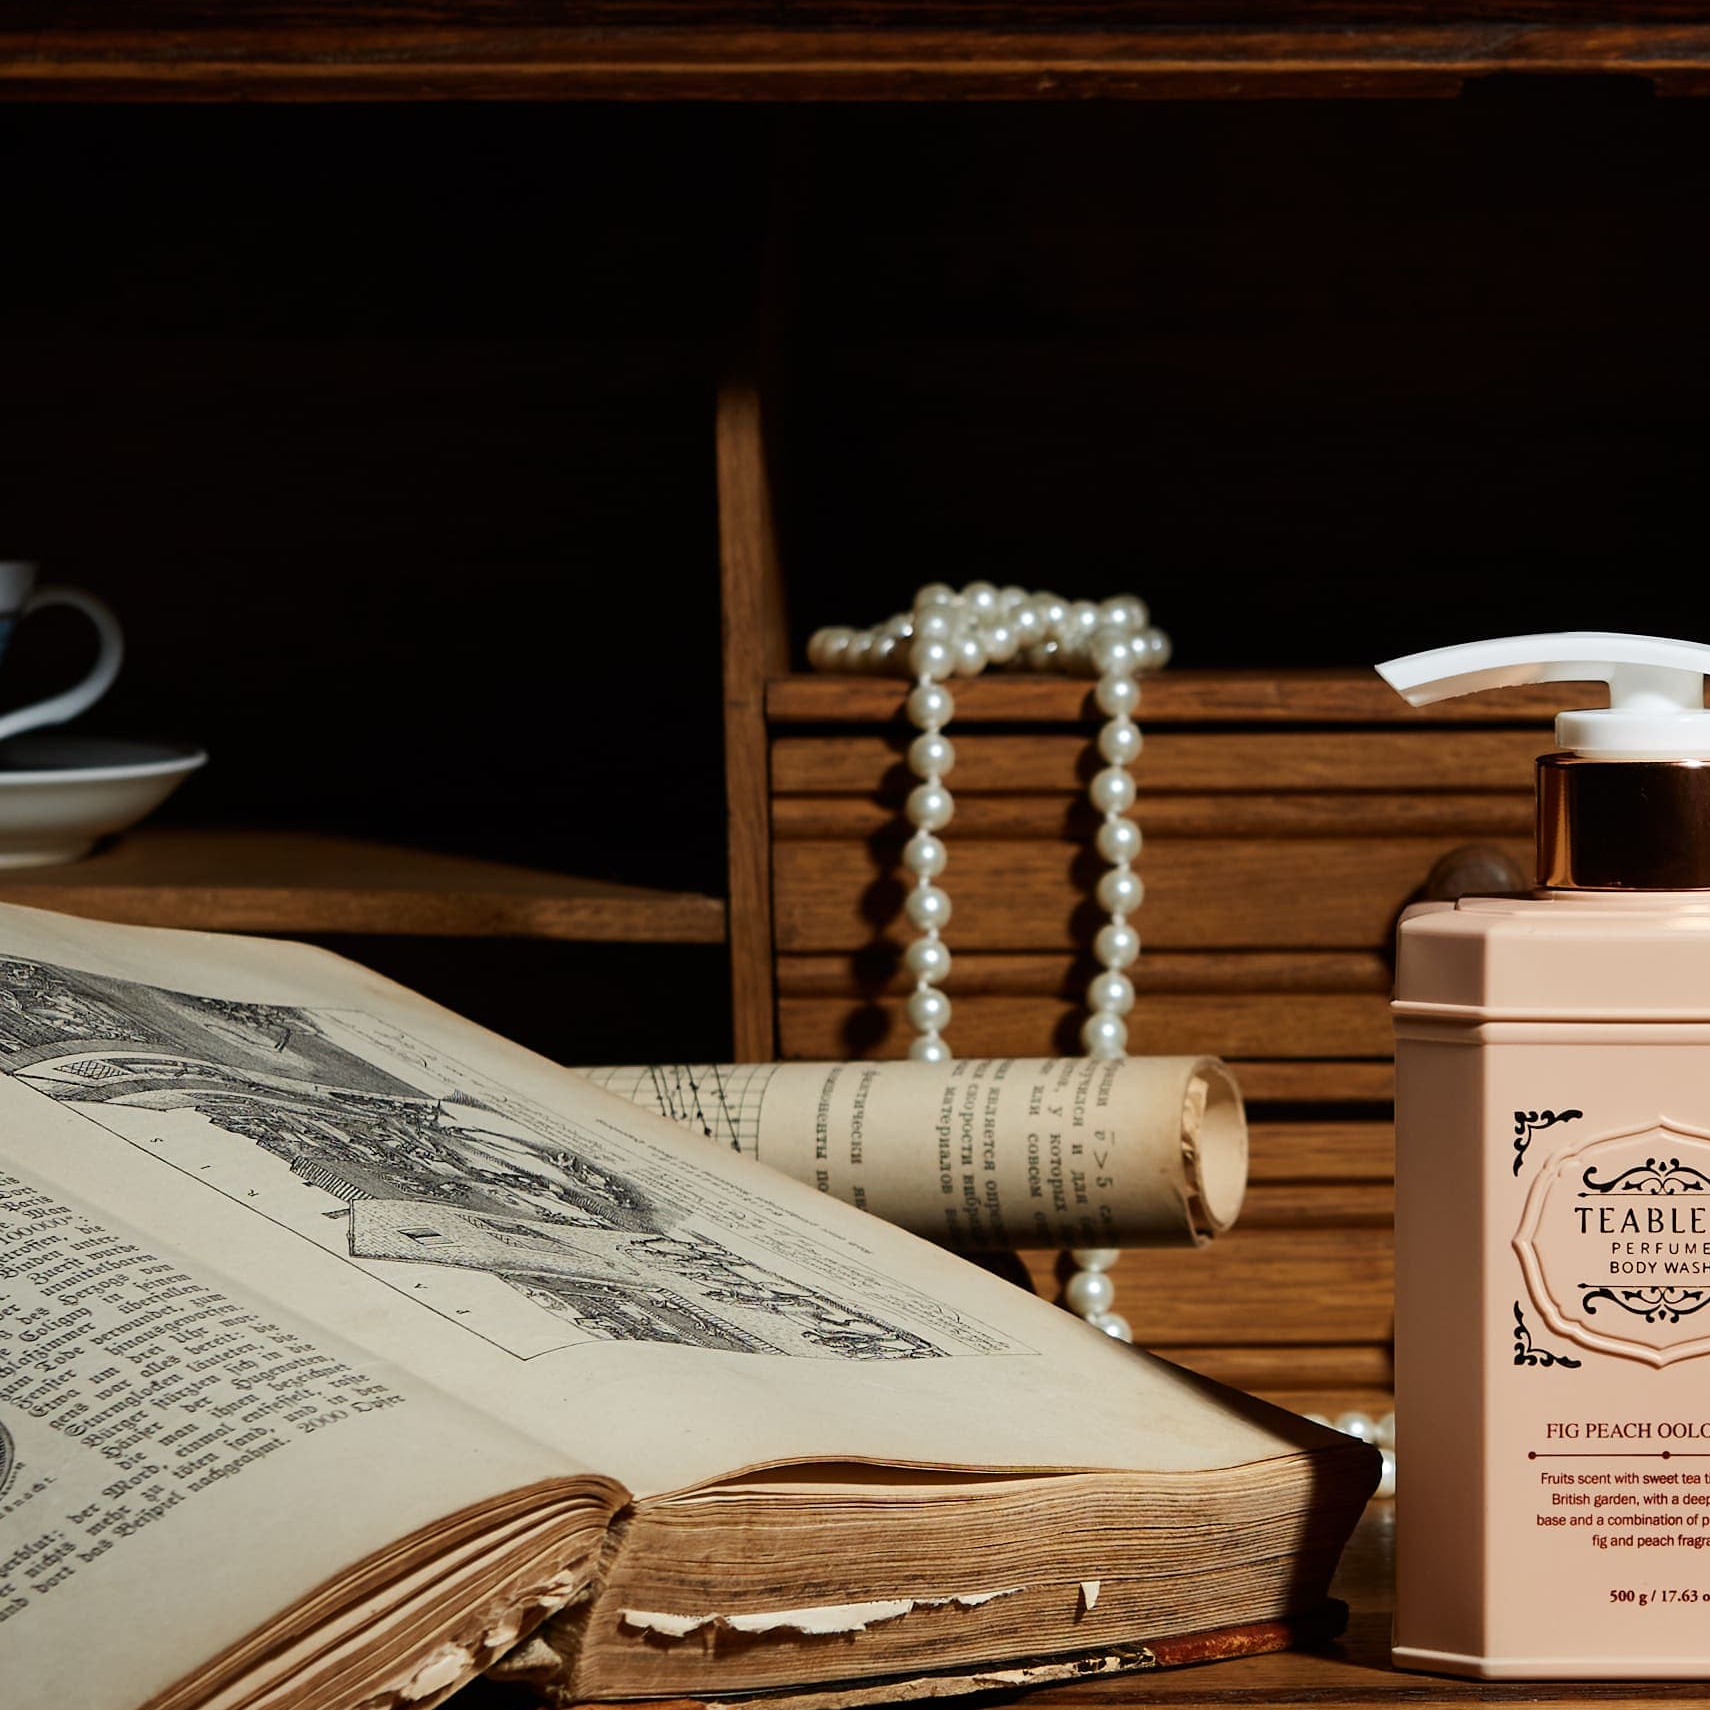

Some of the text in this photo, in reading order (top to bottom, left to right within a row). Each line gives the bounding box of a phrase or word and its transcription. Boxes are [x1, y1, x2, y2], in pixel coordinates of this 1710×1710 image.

[1028, 1133, 1044, 1199] совсем
[1047, 1133, 1068, 1211] которых
[1096, 1176, 1113, 1189] 5
[22, 1206, 71, 1219] Man
[0, 1224, 105, 1267] etroffen, die
[86, 1244, 139, 1260] wurde
[1610, 1261, 1657, 1274] BODY
[1612, 1242, 1710, 1255] PERFUME
[16, 1264, 174, 1325] des Herzogs von
[40, 1248, 157, 1296] unmittelbaren
[19, 1307, 92, 1342] Coligny
[98, 1293, 123, 1303] in
[117, 1285, 209, 1314] überfallen,
[34, 1346, 84, 1372] Tode
[90, 1305, 184, 1344] verwundet,
[190, 1293, 226, 1307] zum
[186, 1343, 264, 1372] läuteten,
[268, 1333, 298, 1343] die
[28, 1389, 80, 1417] Etwa
[89, 1367, 120, 1384] um
[126, 1343, 165, 1363] drei
[169, 1326, 208, 1343] Uhr
[49, 1322, 279, 1430] gens war alles bereit: die
[180, 1396, 212, 1412] der
[231, 1355, 334, 1390] Hugenotten,
[82, 1410, 148, 1448] Bürger
[258, 1351, 282, 1360] in
[286, 1344, 315, 1353] die
[115, 1363, 351, 1470] die man ihnen bezeichnet
[1547, 1423, 1579, 1438] FIG
[1586, 1423, 1651, 1438] PEACH
[24, 1542, 76, 1577] nichts
[86, 1505, 131, 1535] mehr
[140, 1483, 164, 1502] zu
[173, 1452, 219, 1479] töten
[224, 1427, 274, 1450] fand,
[283, 1405, 317, 1422] und
[328, 1395, 348, 1404] in
[353, 1385, 388, 1396] den
[67, 1503, 100, 1524] der
[102, 1464, 168, 1499] Mord,
[176, 1422, 235, 1457] einmal
[1541, 1472, 1575, 1485] Fruits
[1578, 1473, 1611, 1485] scent
[1614, 1472, 1639, 1484] with
[1643, 1473, 1679, 1484] sweet
[1681, 1473, 1701, 1484] tea
[31, 1566, 75, 1593] dort
[76, 1539, 112, 1562] das
[187, 1438, 290, 1492] nachgeahmt.
[299, 1410, 347, 1433] 2000
[1537, 1514, 1566, 1526] base
[1569, 1514, 1593, 1526] and
[1596, 1516, 1604, 1526] a
[1607, 1513, 1683, 1526] combination
[1686, 1513, 1699, 1526] of
[1552, 1493, 1590, 1505] British
[1593, 1493, 1639, 1508] garden,
[1643, 1493, 1668, 1505] with
[1671, 1495, 1679, 1505] a
[1592, 1534, 1608, 1549] fig
[1610, 1535, 1634, 1546] and
[1637, 1535, 1674, 1549] peach
[1610, 1590, 1635, 1603] 500
[1639, 1594, 1648, 1606] g
[1651, 1590, 1656, 1602] /
[1662, 1589, 1698, 1603] 17.63
